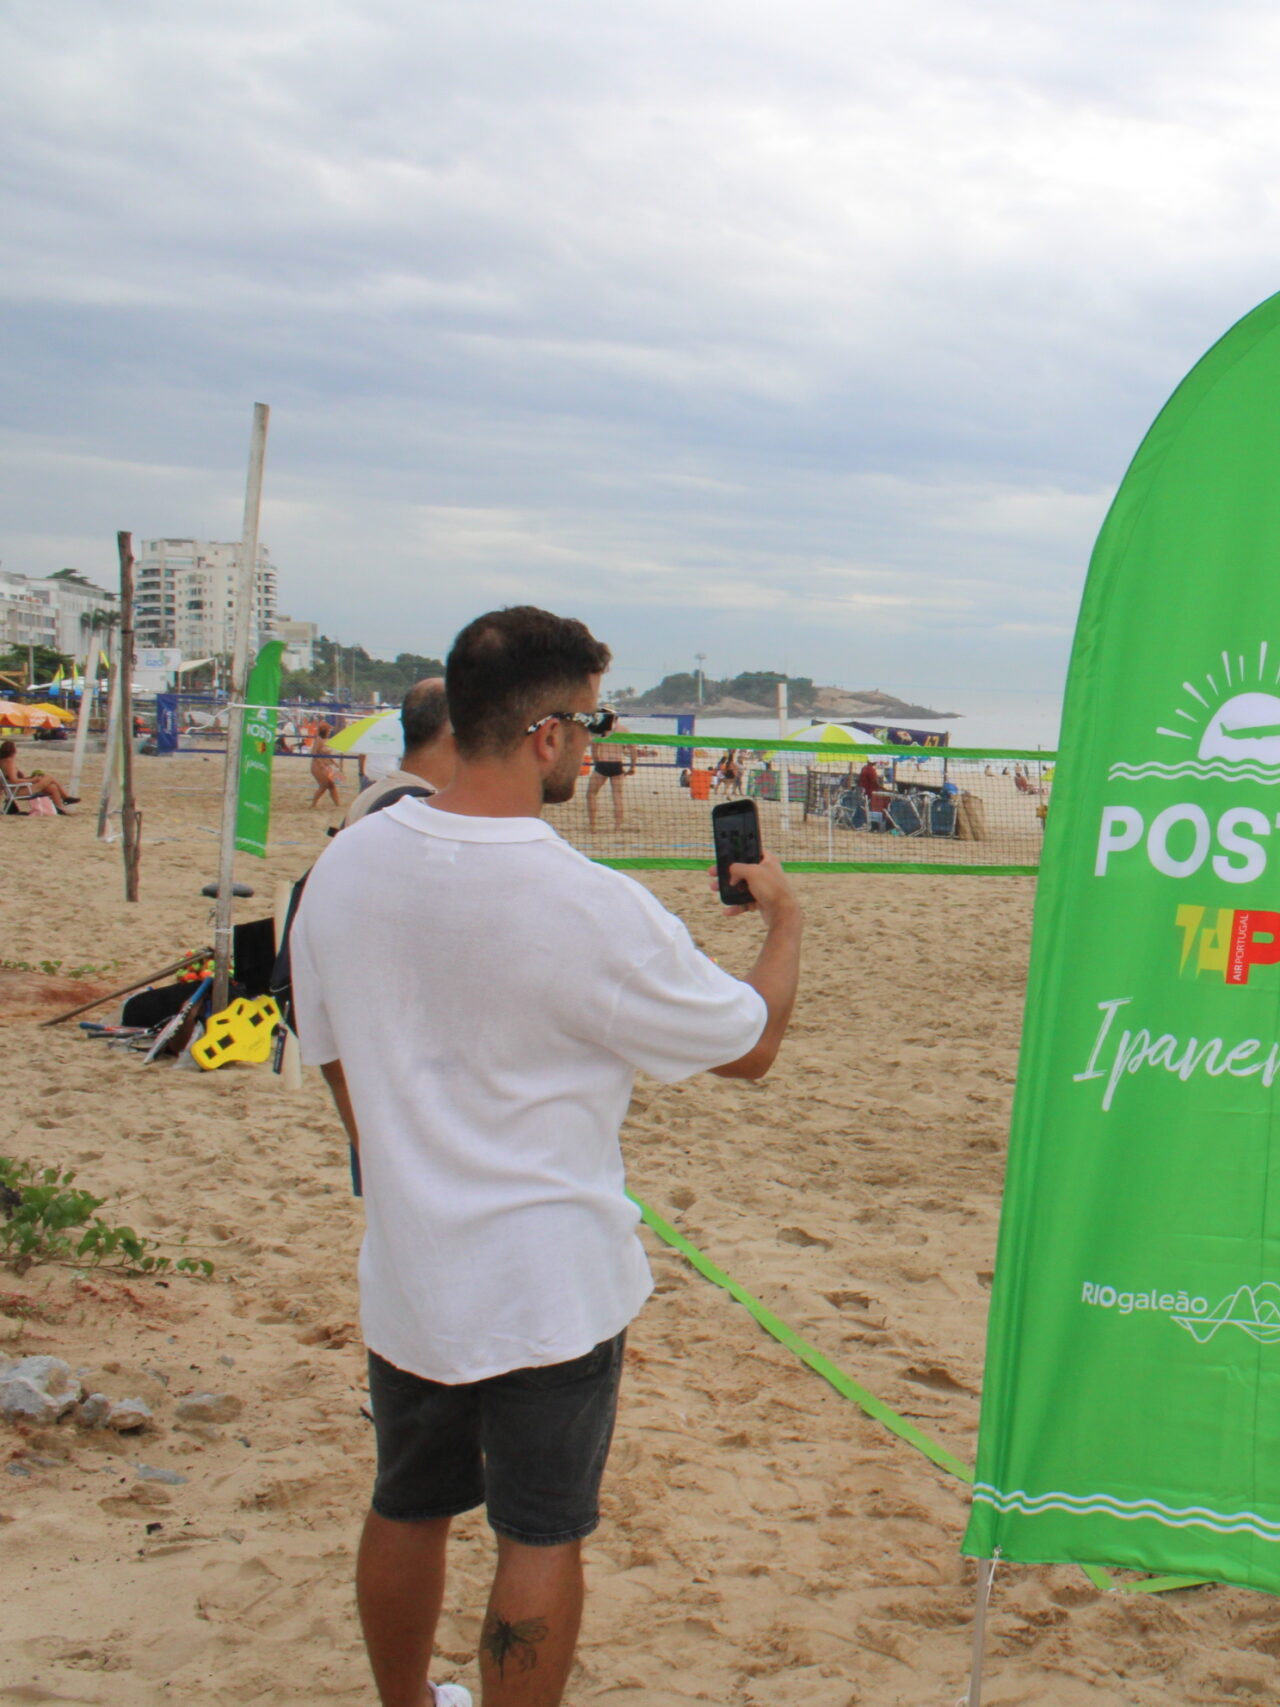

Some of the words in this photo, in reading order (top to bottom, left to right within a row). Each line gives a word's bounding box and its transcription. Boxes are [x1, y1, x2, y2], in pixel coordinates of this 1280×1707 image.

[1235, 913, 1249, 964] PORTUGAL
[1232, 963, 1243, 981] AIR
[1081, 1281, 1208, 1314] RIOgaleão
